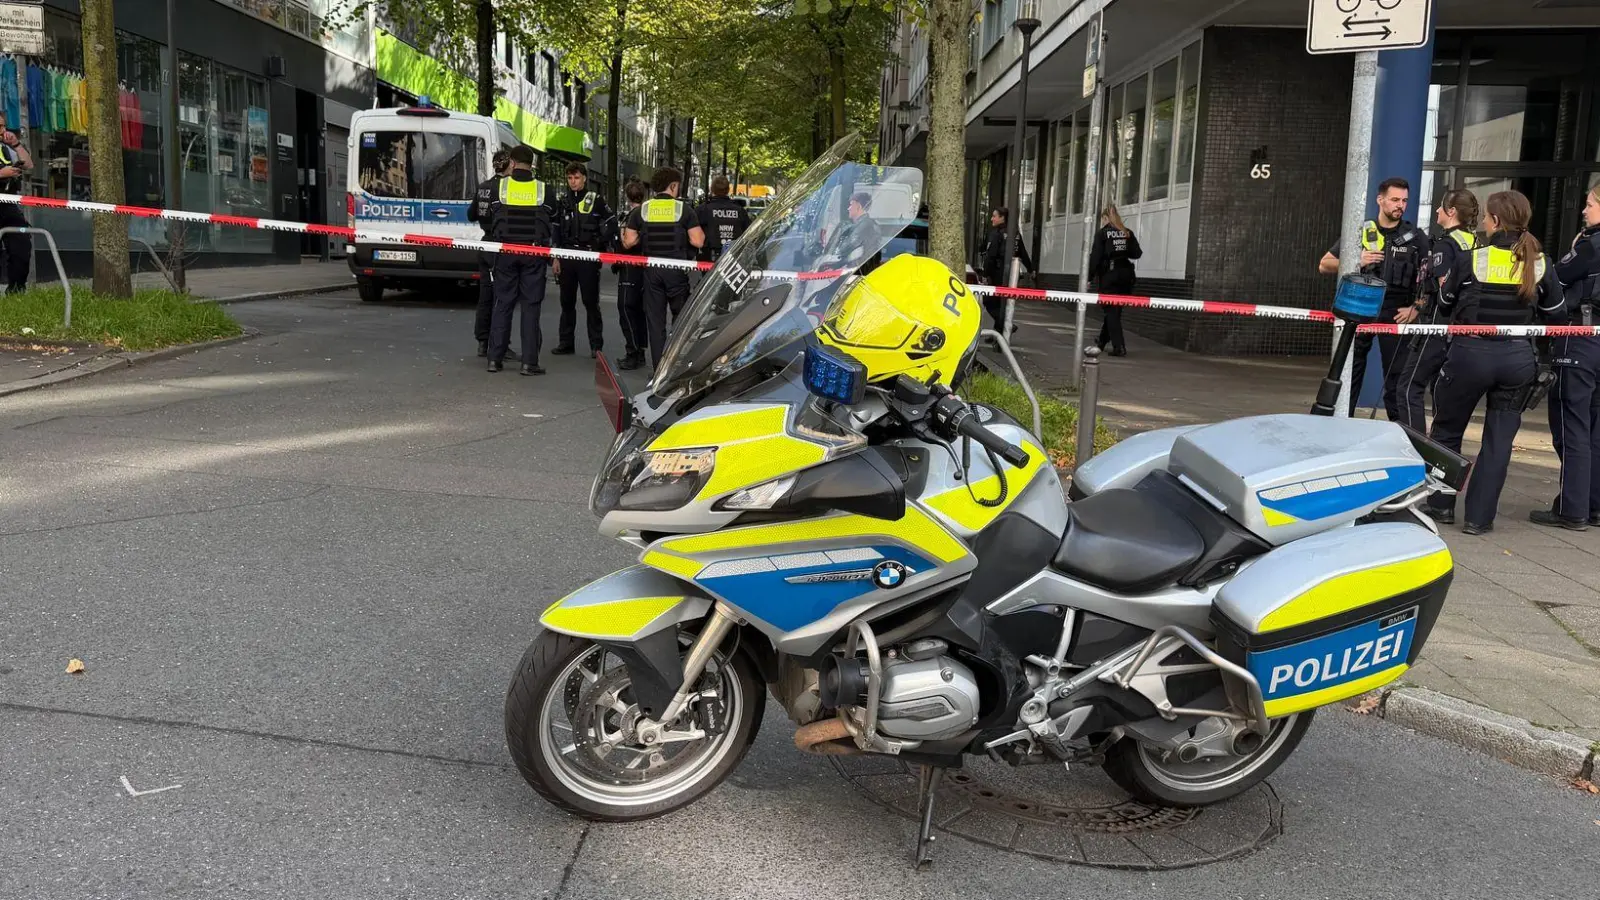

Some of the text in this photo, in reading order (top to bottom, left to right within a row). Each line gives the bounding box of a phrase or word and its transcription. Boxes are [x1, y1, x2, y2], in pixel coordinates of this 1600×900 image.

[1250, 164, 1270, 179] 65
[362, 204, 415, 217] POLIZEI
[713, 209, 739, 219] POLIZEI
[1387, 613, 1408, 626] BMW
[1269, 629, 1404, 694] POLIZEI
